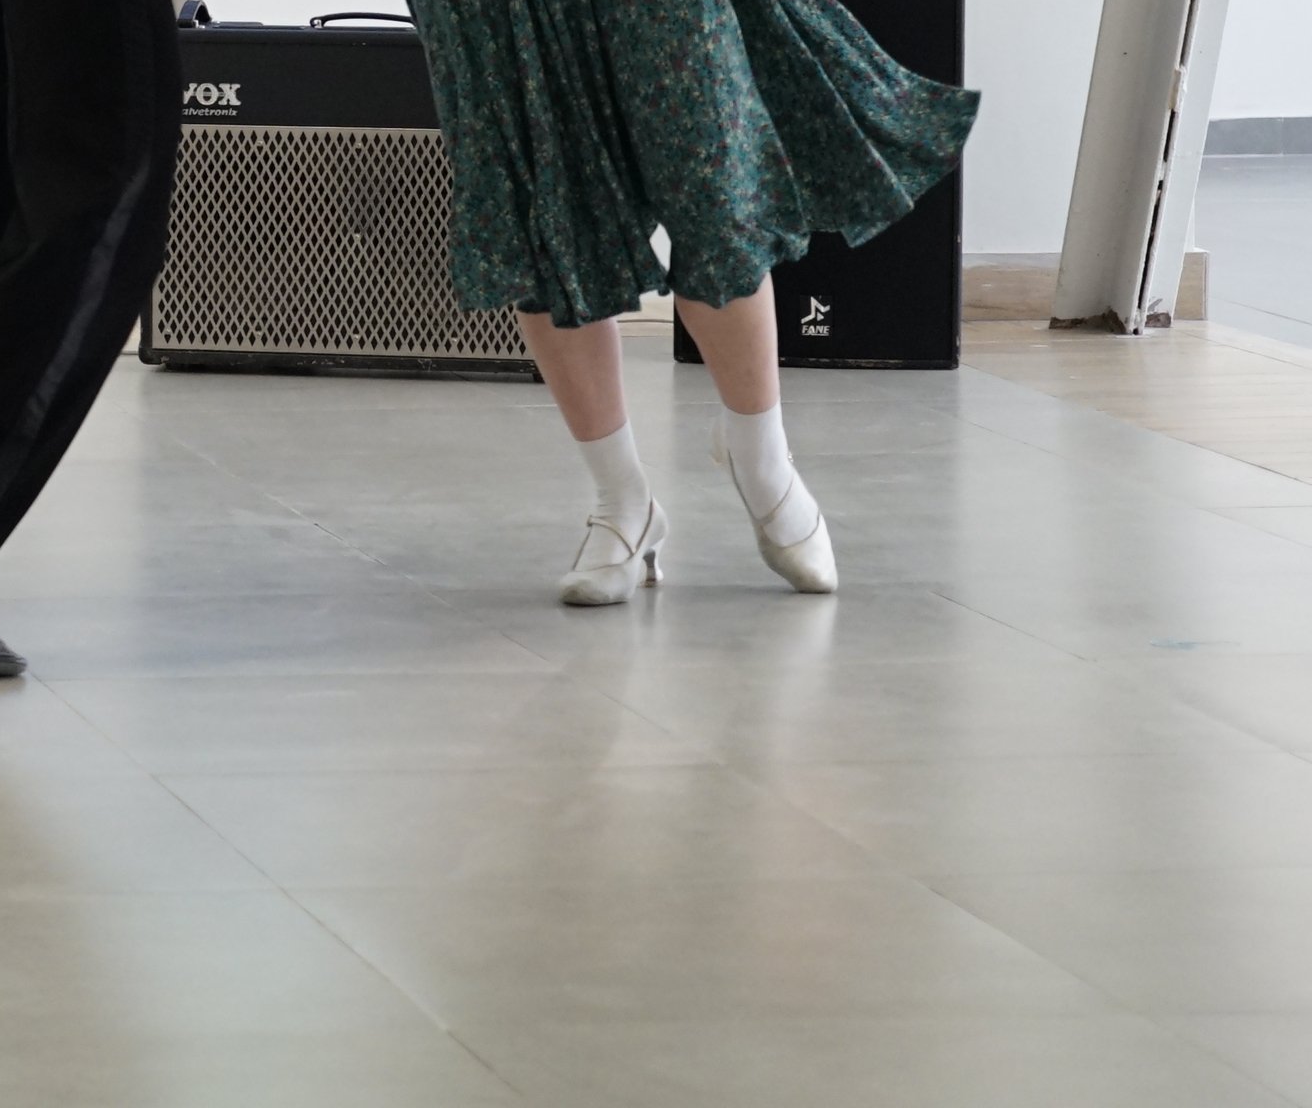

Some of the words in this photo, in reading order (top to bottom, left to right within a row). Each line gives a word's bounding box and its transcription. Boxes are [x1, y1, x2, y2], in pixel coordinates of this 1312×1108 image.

[183, 82, 242, 106] VOX
[182, 107, 238, 117] alvetronix
[801, 325, 831, 336] FANE
